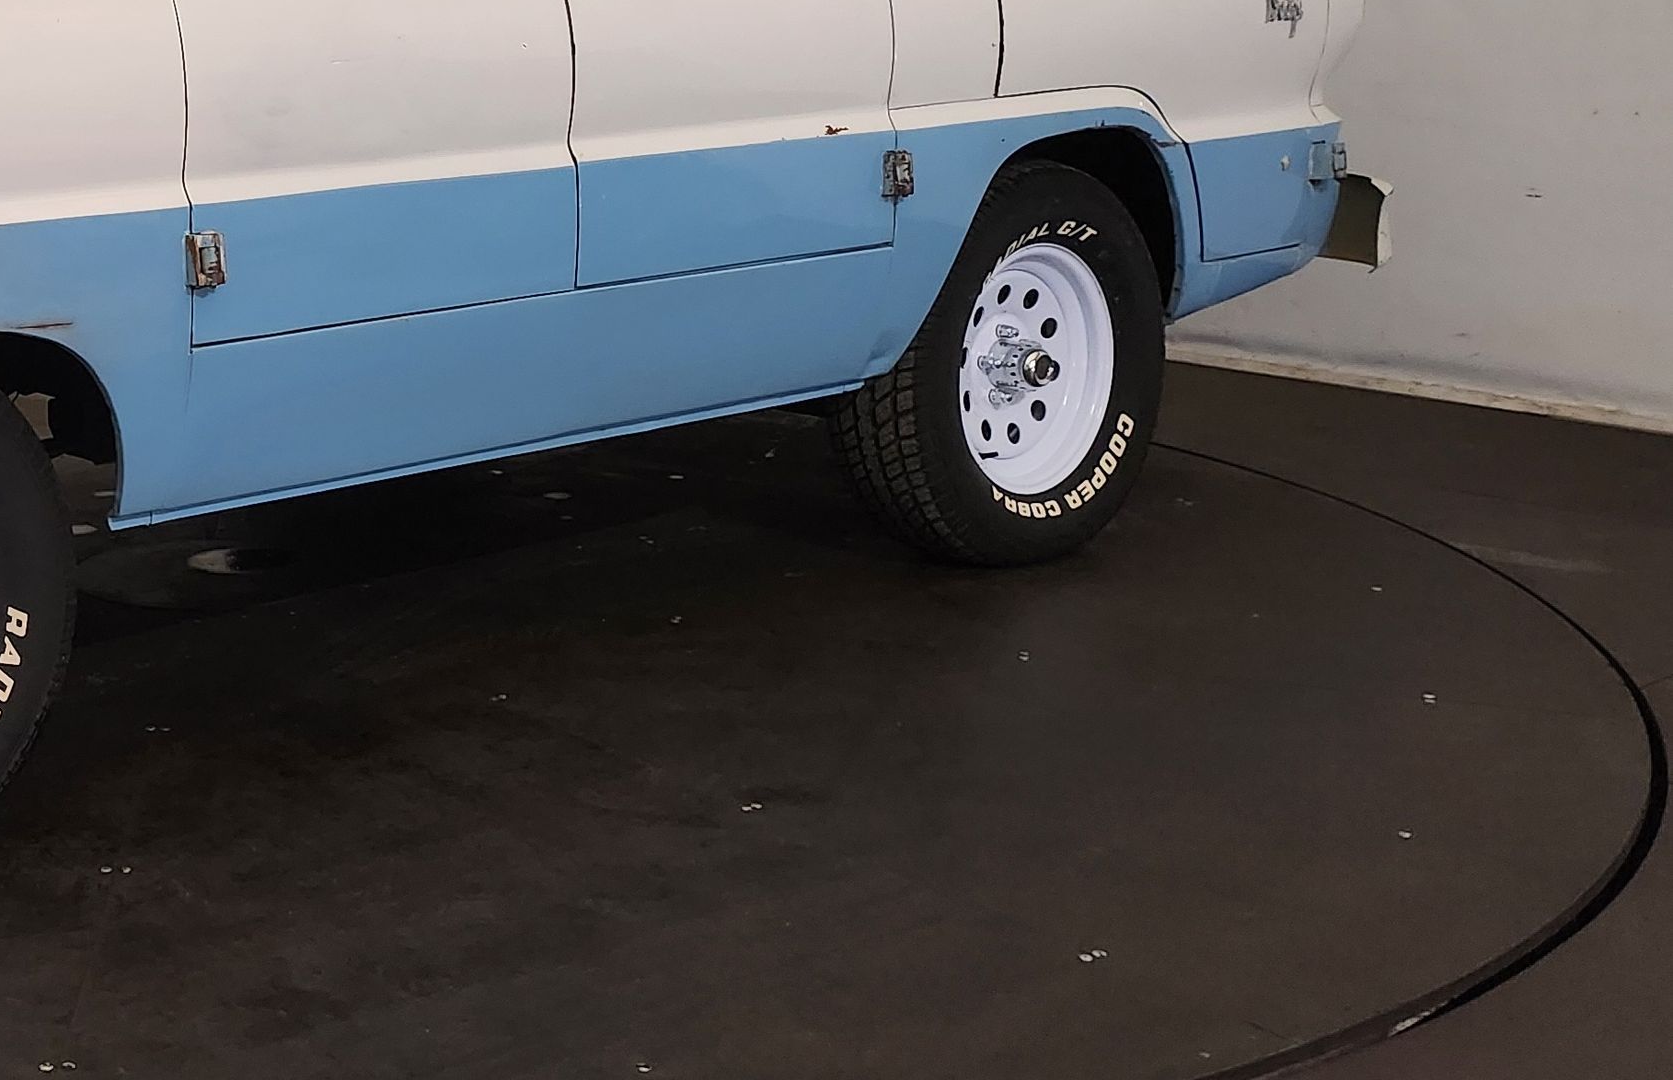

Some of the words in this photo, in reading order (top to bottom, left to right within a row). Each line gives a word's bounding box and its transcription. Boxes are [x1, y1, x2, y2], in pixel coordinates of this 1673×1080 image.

[1056, 220, 1098, 242] G/T
[1063, 413, 1134, 510] COOPER
[991, 485, 1061, 519] COBRA
